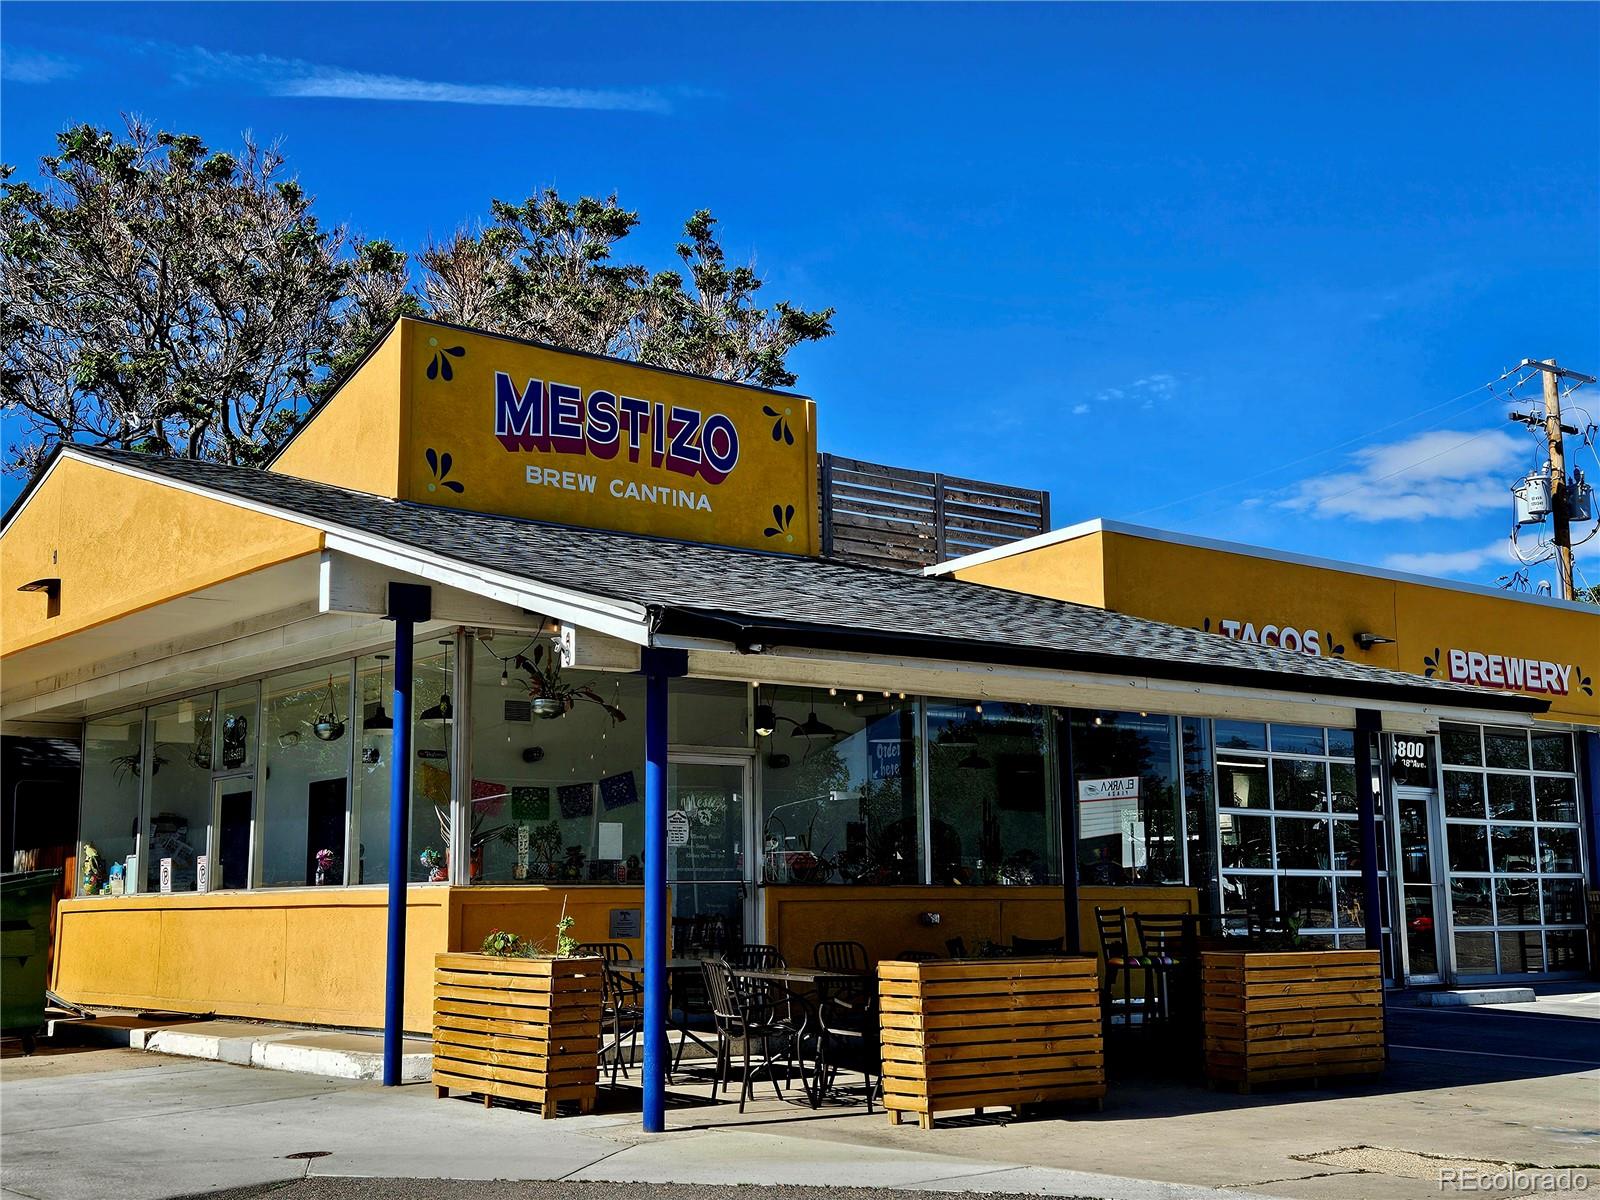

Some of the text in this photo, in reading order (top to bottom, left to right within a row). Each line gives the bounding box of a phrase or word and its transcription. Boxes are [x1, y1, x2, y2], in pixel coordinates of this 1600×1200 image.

[494, 370, 740, 480] MESTIZO
[525, 465, 713, 513] BREW CANTINA
[1221, 619, 1322, 657] TACOS
[1448, 648, 1573, 695] BREWERY
